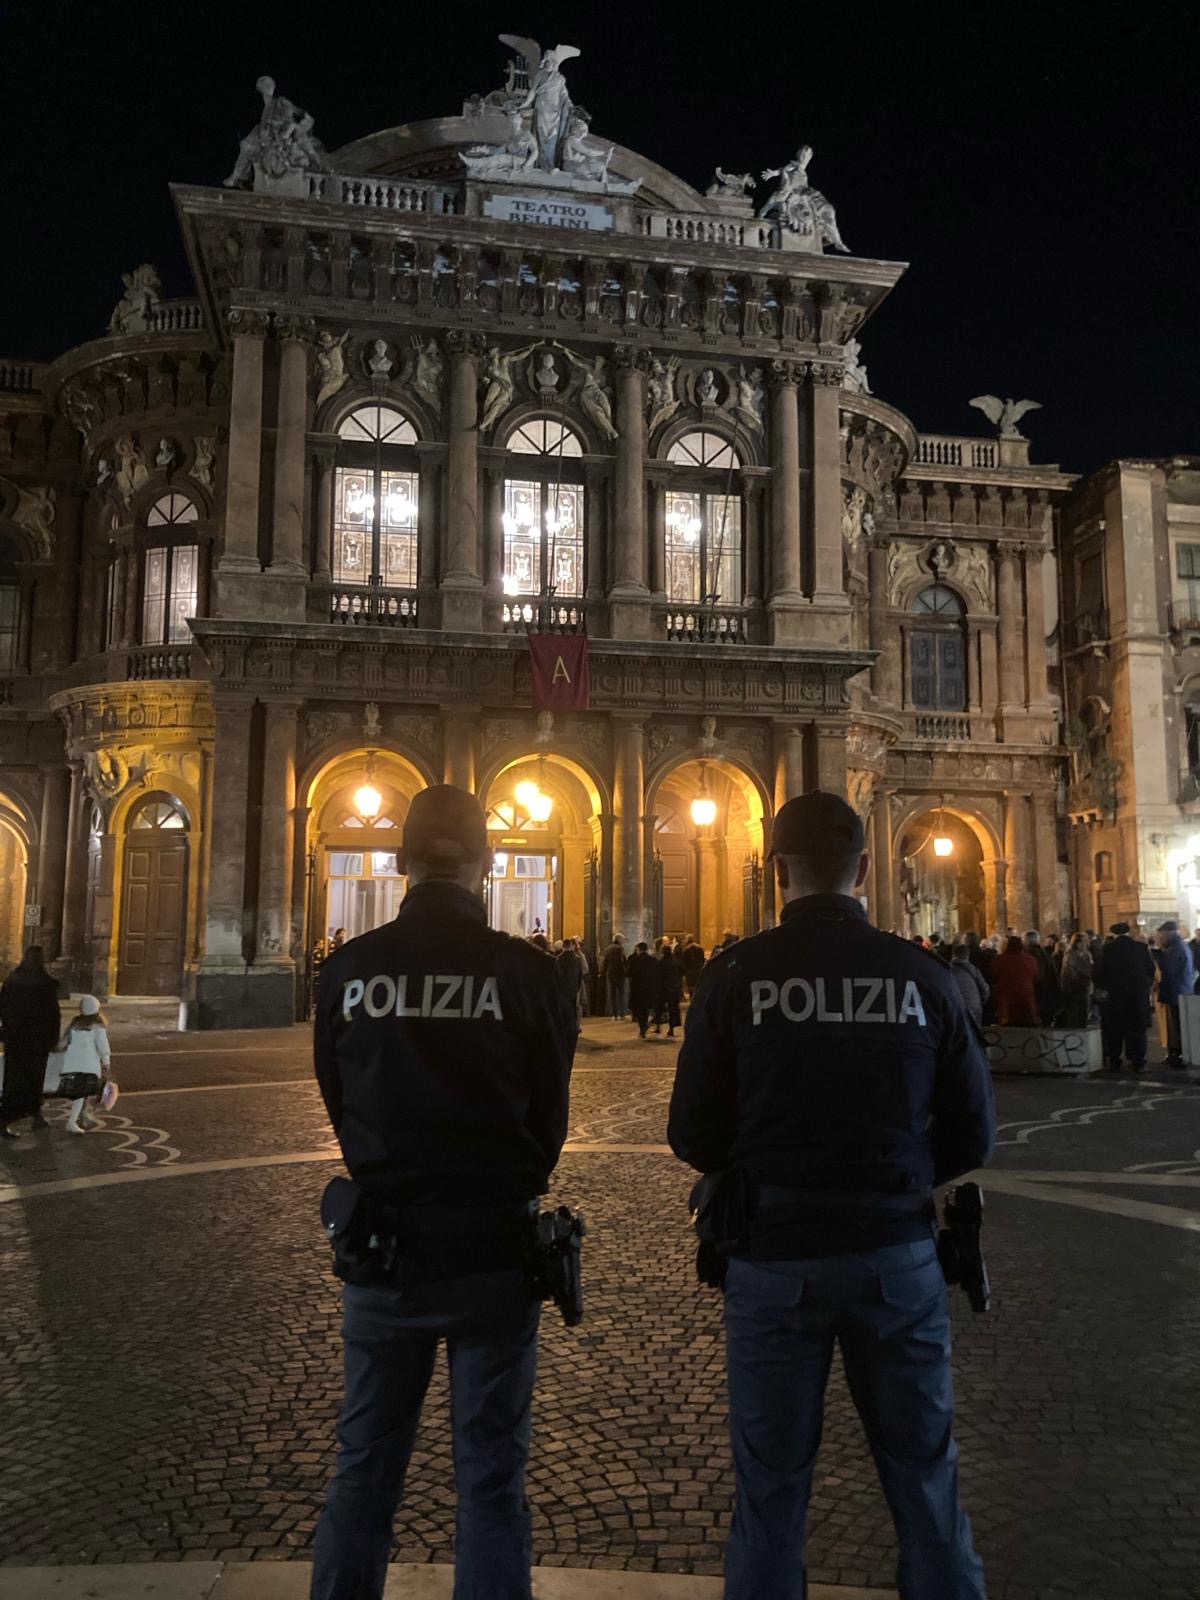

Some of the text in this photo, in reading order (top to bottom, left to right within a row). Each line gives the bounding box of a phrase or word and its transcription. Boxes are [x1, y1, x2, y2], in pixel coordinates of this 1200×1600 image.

[510, 213, 590, 230] BELLINI
[512, 200, 586, 217] TEATRO
[552, 655, 571, 684] A
[343, 974, 503, 1021] POLIZIA
[750, 977, 927, 1026] POLIZIA
